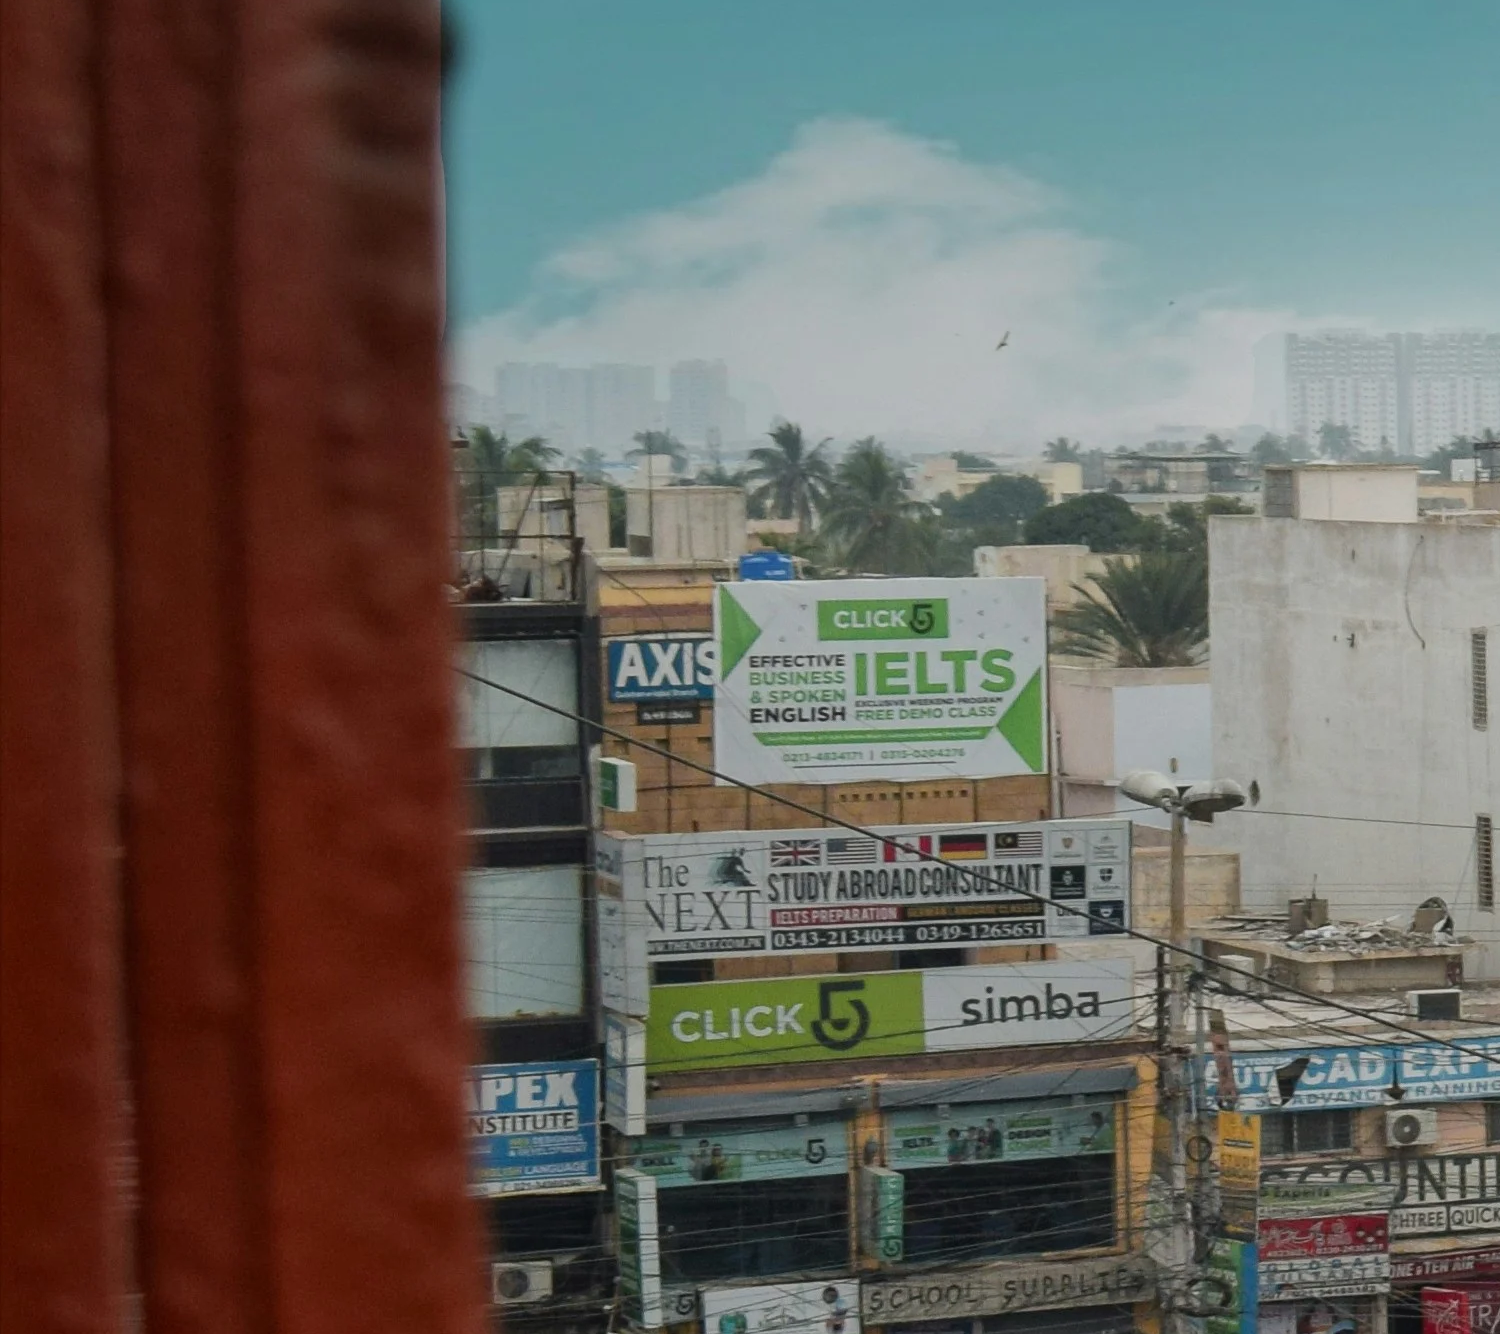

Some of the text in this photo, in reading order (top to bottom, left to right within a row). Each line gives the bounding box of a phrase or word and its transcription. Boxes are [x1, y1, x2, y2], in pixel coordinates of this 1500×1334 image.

[833, 609, 907, 629] CLICK
[615, 641, 716, 687] AXIS
[749, 654, 845, 668] EFFECTIVE
[855, 648, 1016, 696] IELTS
[749, 670, 845, 686] BUSINESS
[750, 689, 846, 703] & SPOKEN
[855, 696, 1003, 707] EXCLUSIVE WEEKEND PROGRAM
[750, 706, 846, 724] ENGLISH
[855, 706, 997, 721] FREE DEMO CLASS
[643, 855, 690, 888] The
[767, 863, 1043, 903] STUDY ABROAD CONSULTANT
[645, 889, 761, 933] NEXT
[775, 906, 898, 925] IELTS PREPARATION
[960, 982, 1101, 1030] simba
[670, 1003, 804, 1045] CLICK
[468, 1112, 574, 1135] NSTITUTE
[869, 1281, 979, 1312] SCHOOL
